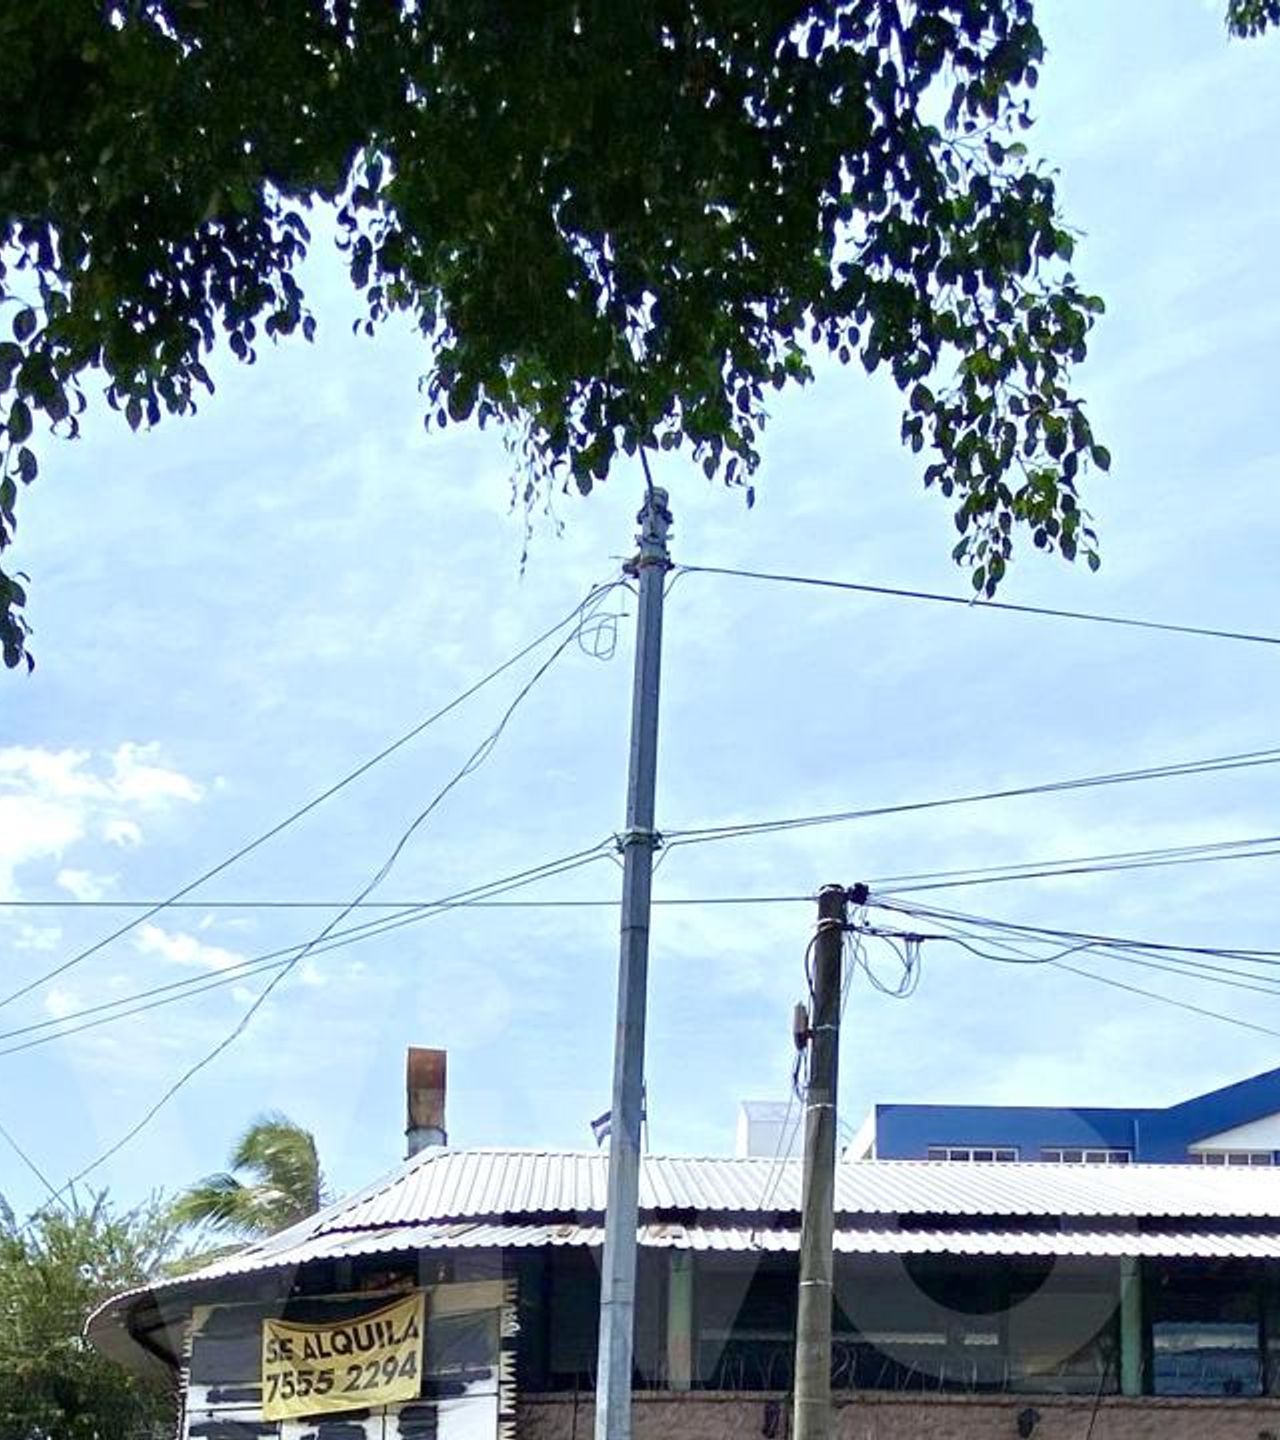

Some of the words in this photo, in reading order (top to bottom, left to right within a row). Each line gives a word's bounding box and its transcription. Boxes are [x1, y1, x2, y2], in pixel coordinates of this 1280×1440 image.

[265, 1337, 294, 1364] SE
[302, 1315, 419, 1361] ALQUILA
[266, 1368, 336, 1404] 7555
[342, 1350, 418, 1394] 2294
